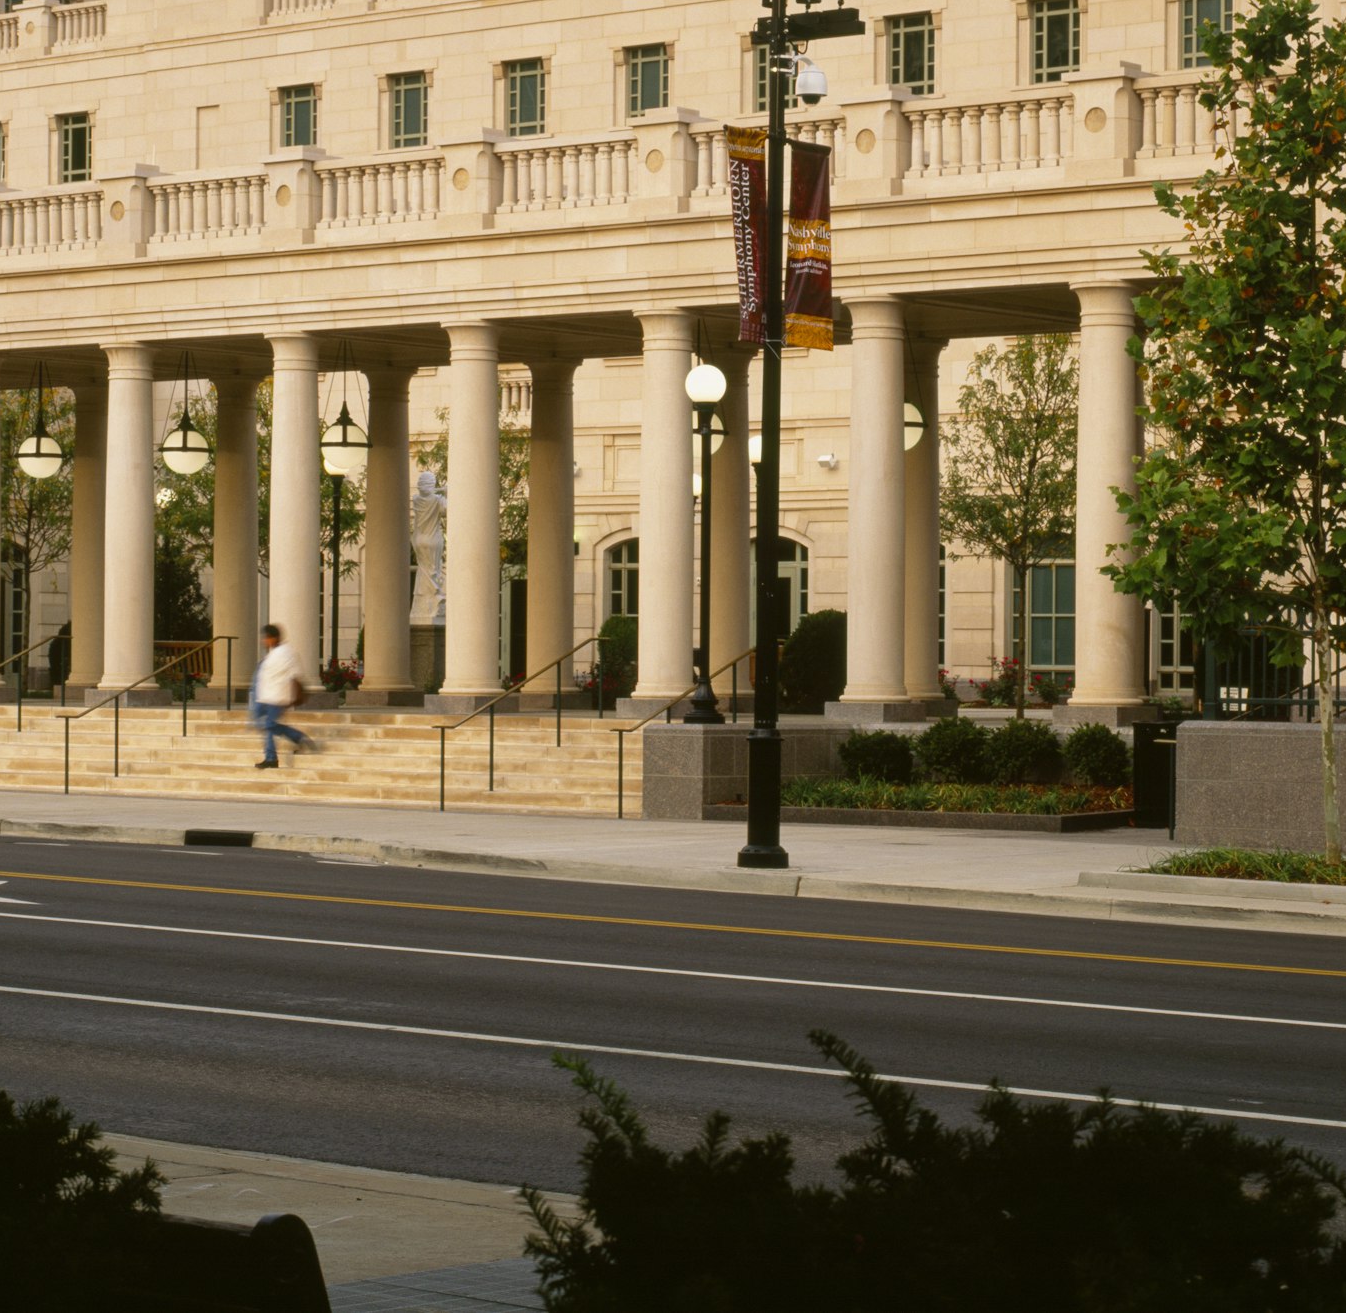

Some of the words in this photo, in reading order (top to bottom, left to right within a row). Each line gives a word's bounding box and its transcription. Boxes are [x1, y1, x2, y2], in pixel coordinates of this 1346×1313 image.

[741, 162, 750, 220] Center
[729, 159, 749, 319] SCHERMERHORN
[788, 239, 830, 257] Symphony
[789, 224, 831, 239] Nashville
[744, 224, 758, 312] Symphony
